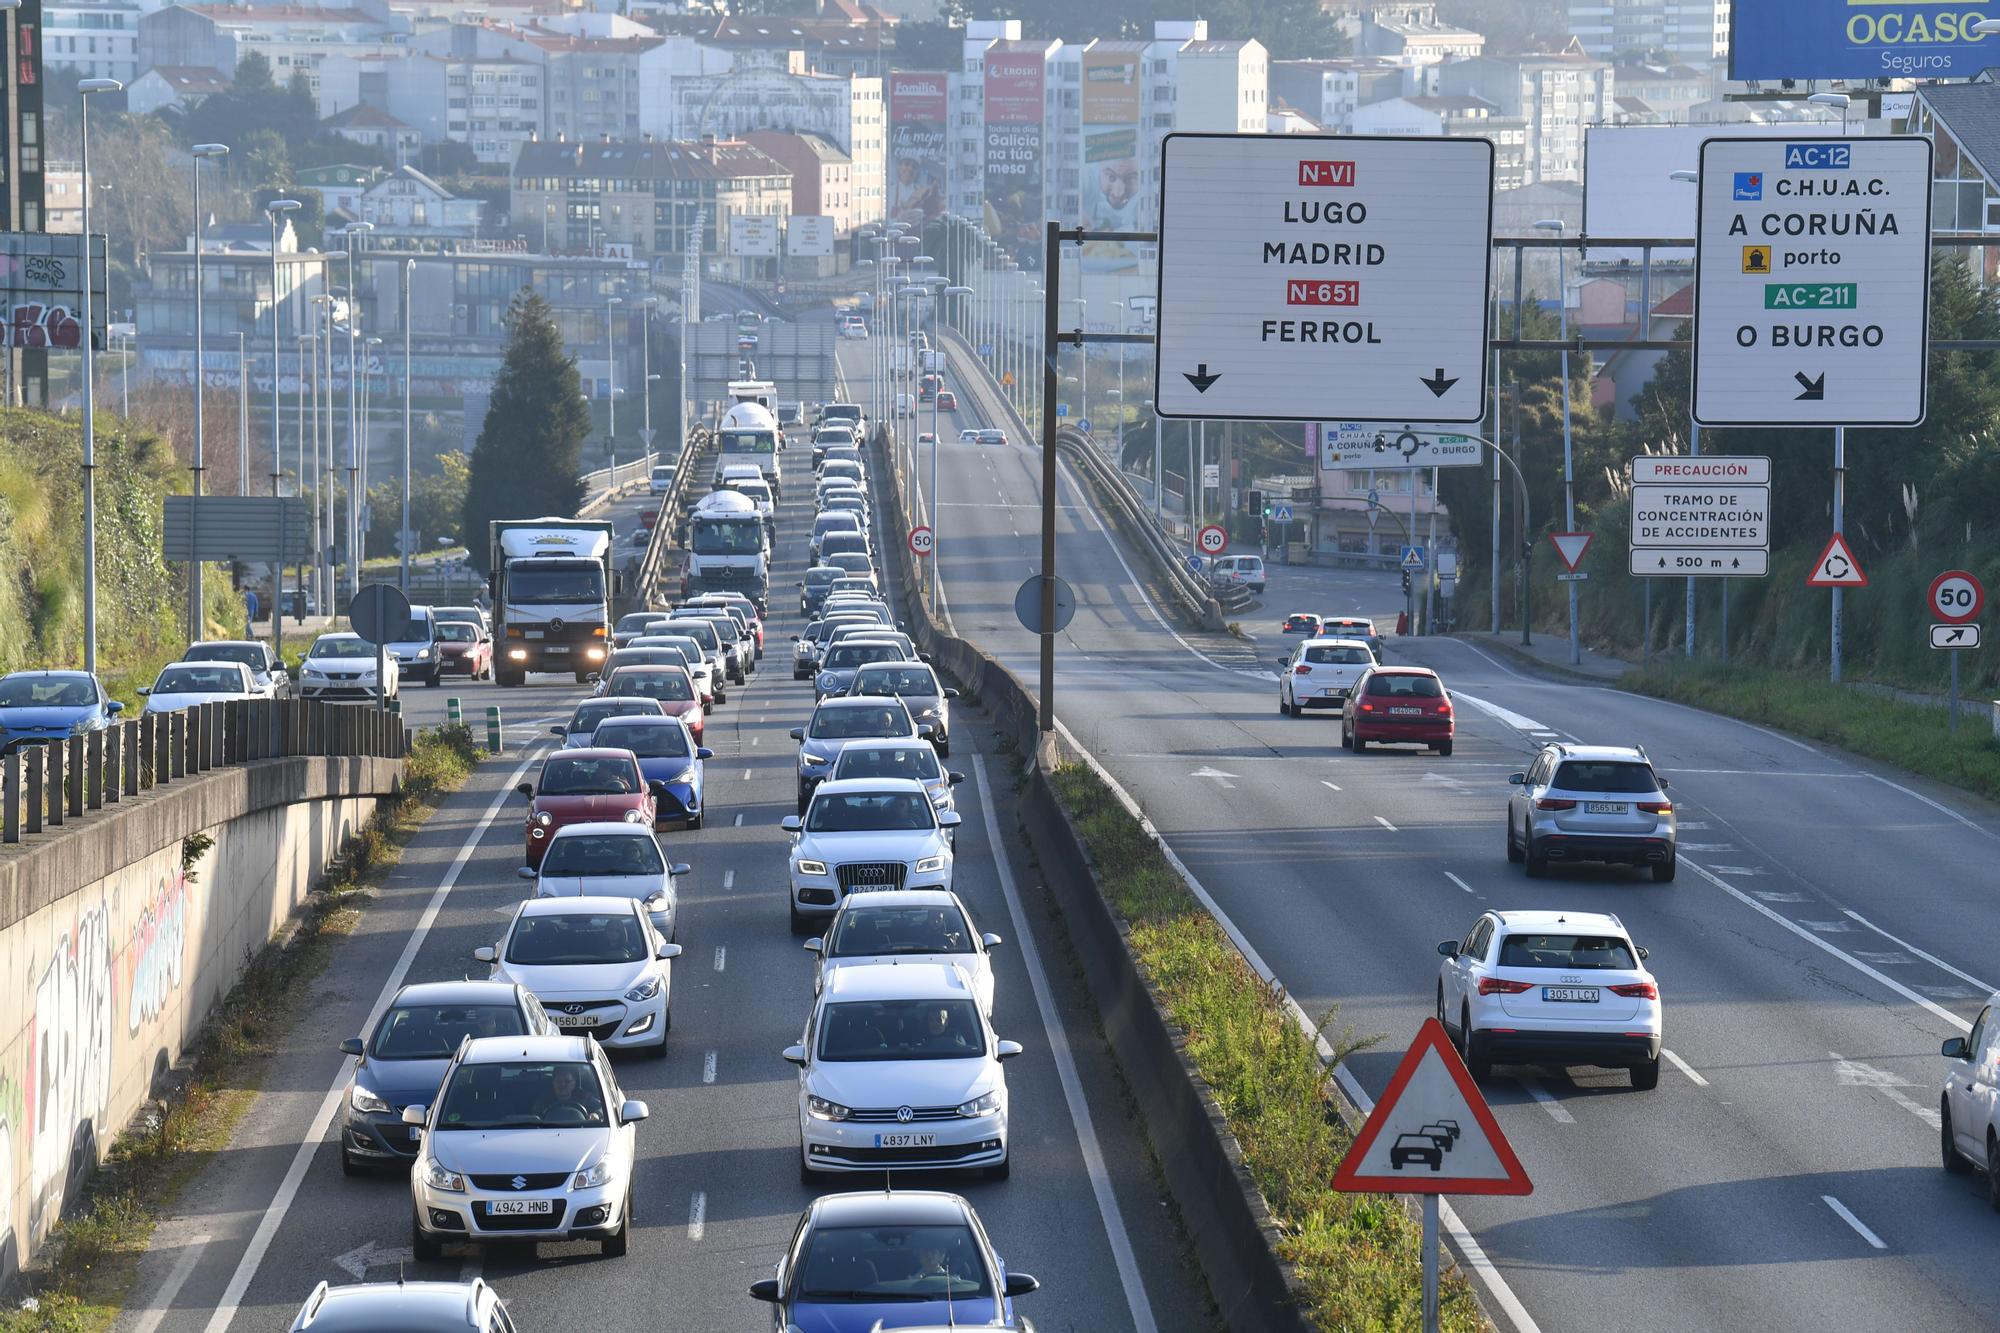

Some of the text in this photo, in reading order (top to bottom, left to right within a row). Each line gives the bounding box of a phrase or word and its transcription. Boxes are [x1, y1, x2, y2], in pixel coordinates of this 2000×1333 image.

[1881, 51, 1952, 74] Seguros
[1003, 67, 1037, 76] EROSKI
[988, 134, 1039, 146] Galicia
[988, 147, 1033, 160] na túa
[1786, 148, 1849, 166] AC-12
[988, 163, 1026, 174] mesa
[1302, 164, 1352, 183] N-VI
[1776, 179, 1890, 196] C.H.U.A.C.
[1284, 201, 1367, 224] LUGO
[1728, 208, 1899, 236] A CORUÑA
[1263, 242, 1385, 265] MADRID
[1784, 249, 1841, 268] porto
[1290, 283, 1356, 303] N-651
[1773, 287, 1849, 305] AC-211
[1262, 320, 1381, 344] FERROL
[1736, 325, 1884, 347] O BURGO
[1327, 442, 1334, 450] A
[1432, 446, 1476, 455] O BURGO
[1654, 463, 1748, 475] PRECAUCIÓN
[1664, 495, 1737, 506] TRAMO DE
[1637, 509, 1763, 522] CONCENTRACIÓN
[1642, 527, 1757, 538] DE ACCIDENTES
[914, 535, 931, 546] 50
[1204, 535, 1221, 545] 50
[1676, 557, 1722, 567] 500 m
[1940, 588, 1972, 607] 50
[1549, 989, 1596, 1000] 3051 LCX
[580, 1016, 599, 1025] JCM
[883, 1134, 934, 1146] 4837 LNY
[495, 1201, 549, 1213] 4942 HNB
